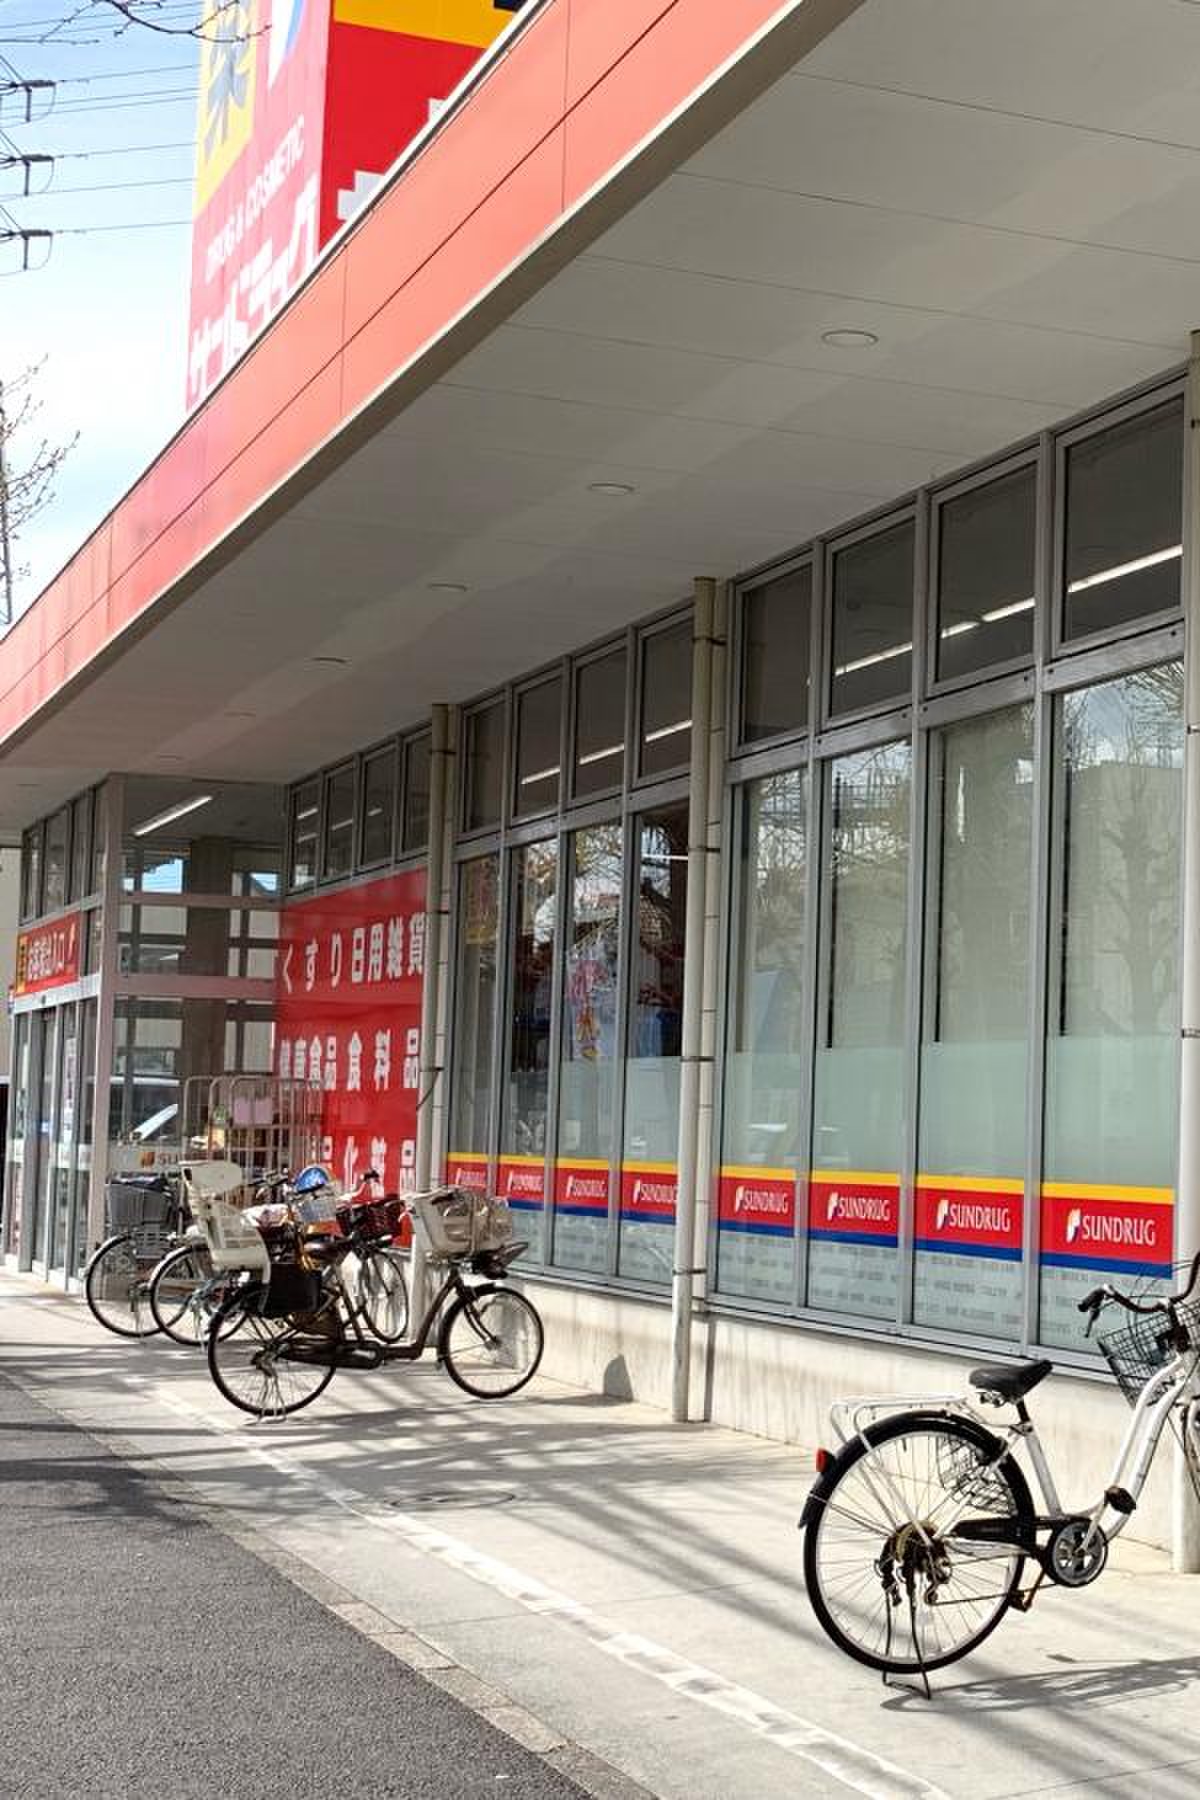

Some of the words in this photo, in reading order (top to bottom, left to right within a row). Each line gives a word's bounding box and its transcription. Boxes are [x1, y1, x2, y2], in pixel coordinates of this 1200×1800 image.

[743, 1187, 788, 1214] SUNDRUG
[837, 1197, 891, 1222] SUNDRUG
[950, 1203, 1011, 1233] SUNDRUG
[1082, 1214, 1156, 1246] SUNDRUG
